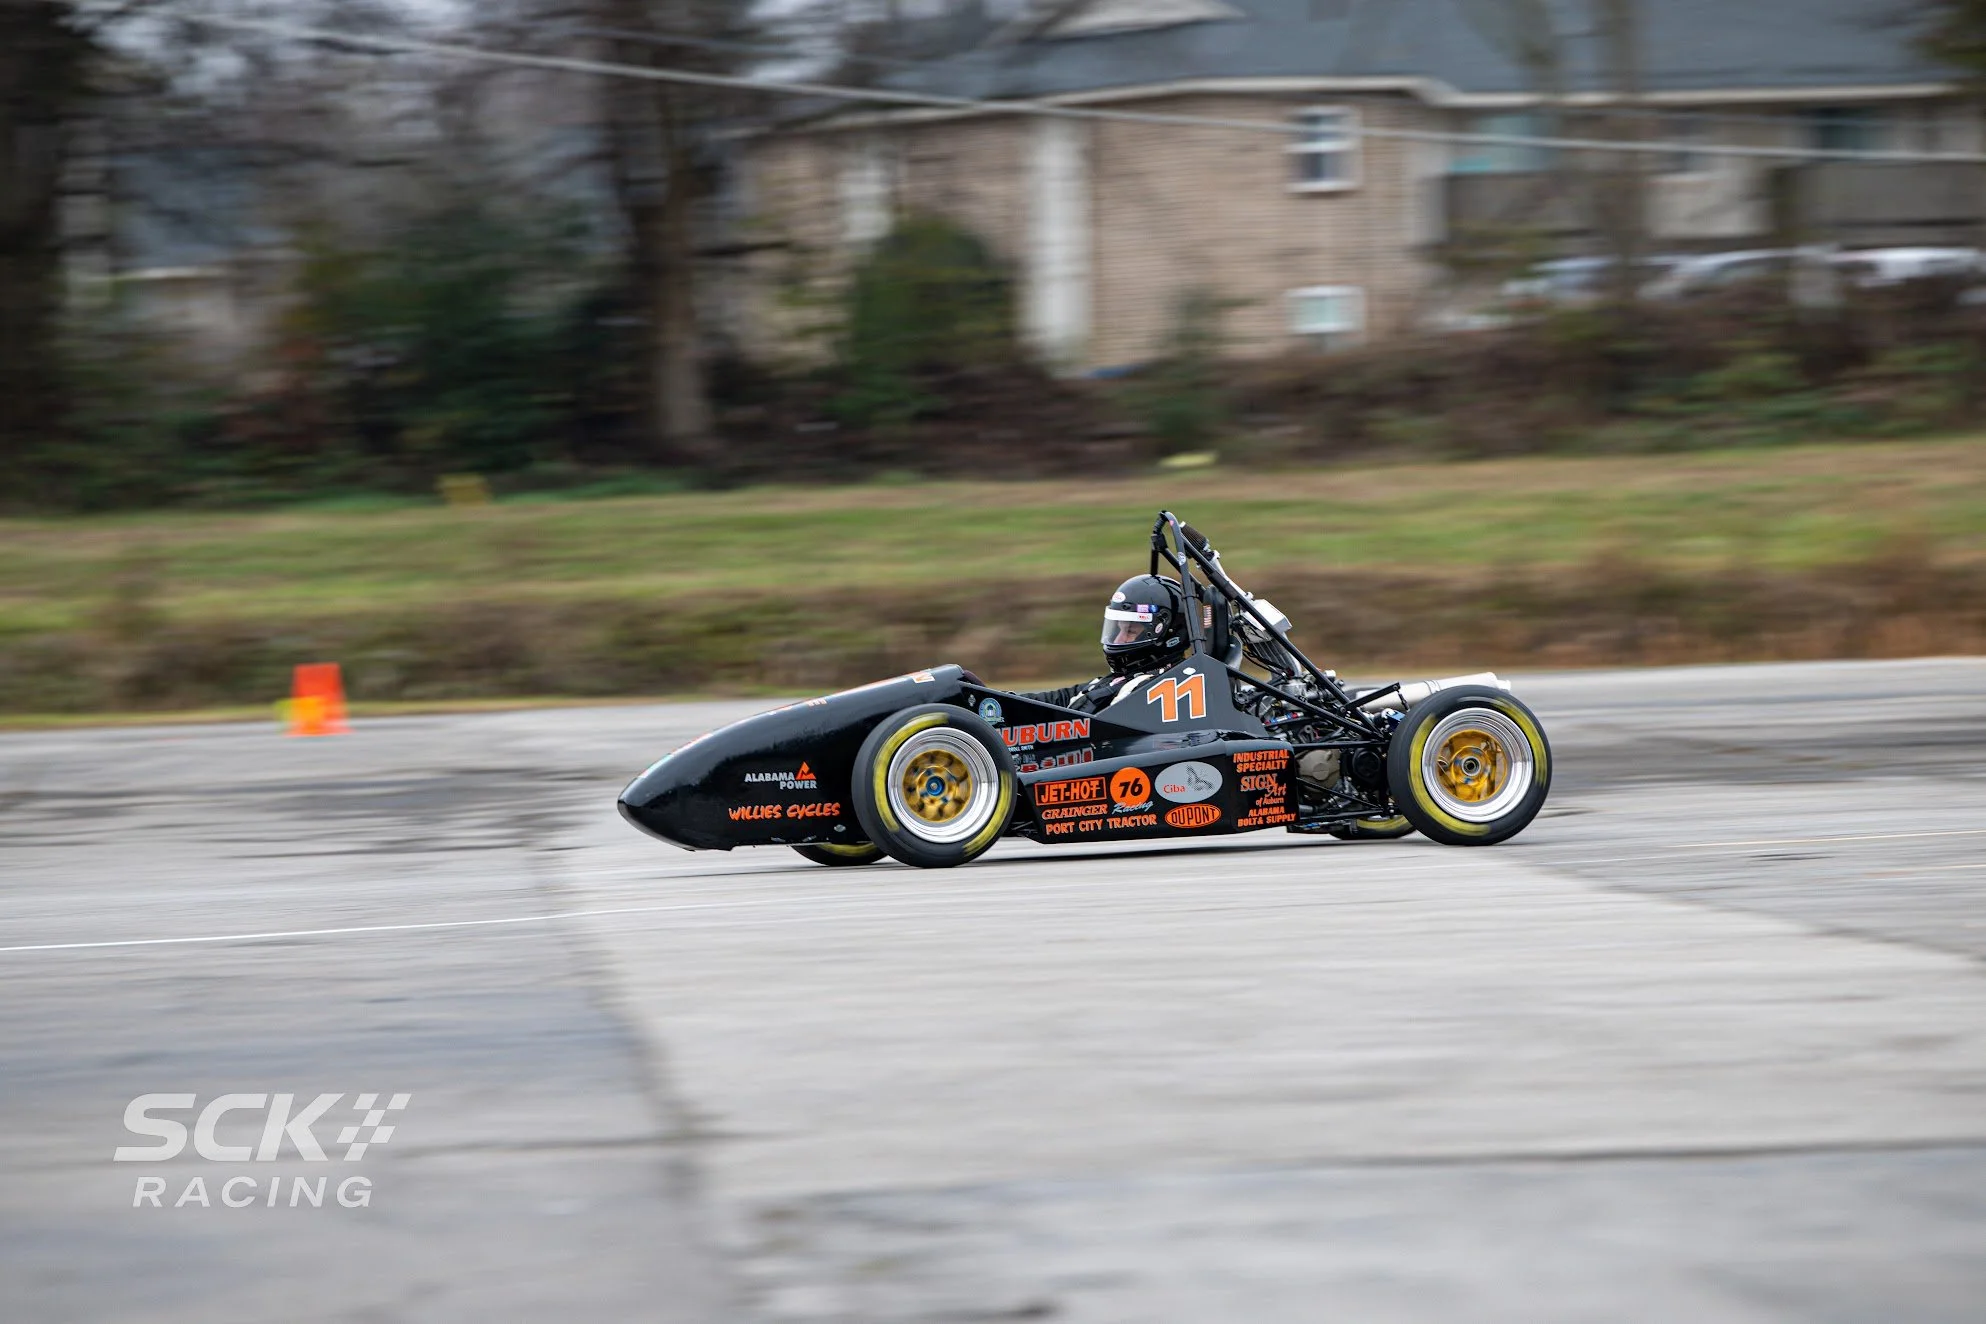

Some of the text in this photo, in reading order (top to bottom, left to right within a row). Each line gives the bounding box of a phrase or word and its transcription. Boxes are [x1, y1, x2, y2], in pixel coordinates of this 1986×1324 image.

[1147, 674, 1206, 722] 11
[998, 718, 1091, 747] UBURN
[1233, 749, 1290, 763] INDUSTRIAL
[1236, 760, 1288, 773] SPECIALTY
[744, 771, 796, 782] ALABAMA
[1240, 773, 1278, 792] SIGN
[780, 780, 817, 790] POWER
[1041, 780, 1101, 803] JET-HOT
[1119, 778, 1143, 798] 76
[1163, 784, 1186, 793] Ciba
[1264, 782, 1287, 797] Art
[1112, 800, 1154, 814] Racing
[1256, 797, 1285, 807] of Auburn
[728, 802, 841, 820] WILLIES CYCLES
[1042, 804, 1108, 820] GRAINGER
[1248, 806, 1285, 817] ALABAMA
[1045, 814, 1157, 836] PORT CITY TRACTOR
[1266, 813, 1297, 824] SUPPLY
